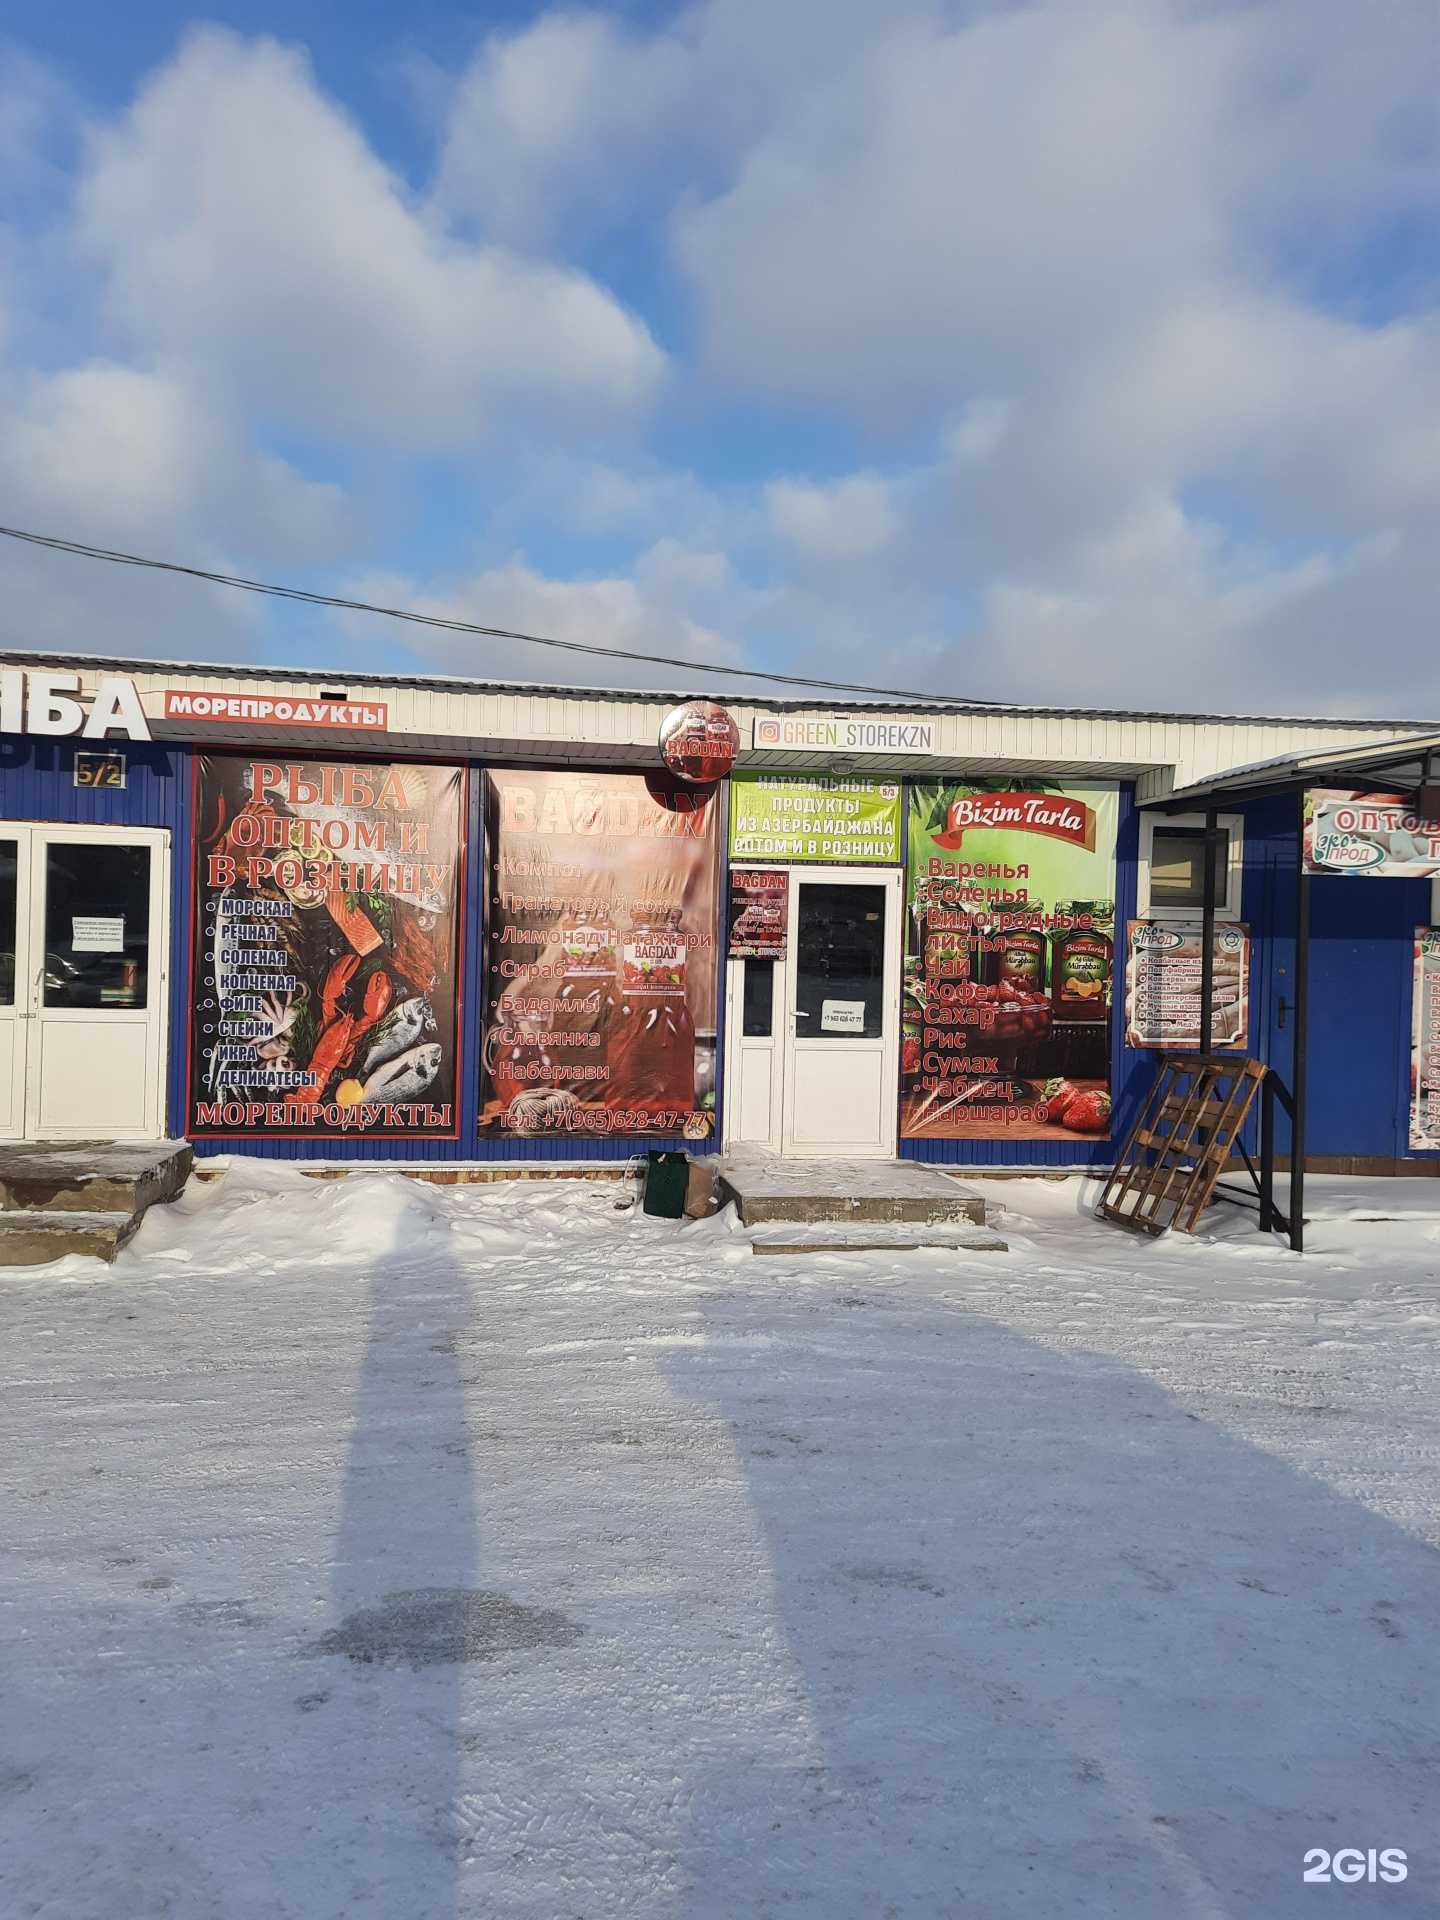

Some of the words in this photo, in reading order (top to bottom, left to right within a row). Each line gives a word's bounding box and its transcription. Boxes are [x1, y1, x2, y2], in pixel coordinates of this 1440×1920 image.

[168, 695, 383, 726] МОРЕПРОДУКТЫ
[784, 722, 931, 749] GREEN_STOREKZN
[78, 763, 121, 785] 5/2
[758, 776, 875, 793] НАТУРАЛЬНЫЕ
[250, 763, 409, 810] РЫБА
[772, 797, 860, 814] ПРОДУКТЫ
[952, 800, 1023, 826] Bizim
[1024, 800, 1083, 830] Tarla
[231, 815, 387, 853] ОПТОМ
[400, 823, 429, 854] И
[736, 817, 757, 832] ИЗ
[762, 818, 895, 835] АЗЕРБАЙДЖАНА
[792, 839, 802, 853] И
[808, 840, 817, 854] В
[822, 841, 895, 856] РОЗНИЦУ
[1329, 848, 1370, 861] ПРОД
[207, 855, 236, 887] В
[247, 857, 452, 899] РОЗНИЦУ
[928, 858, 1029, 880] Варенья
[927, 881, 1029, 902] Соленья
[221, 899, 291, 917] МОРСКАЯ
[502, 892, 628, 913] Гранатовый
[926, 906, 1093, 931] Виноградные
[221, 925, 276, 941] РЕЧНАЯ
[500, 926, 602, 948] Лимонад
[608, 930, 712, 951] Натахтари
[1143, 935, 1173, 945] ПРОД
[220, 950, 287, 966] СОЛЕНАЯ
[925, 954, 970, 976] Чай
[500, 960, 566, 982] Сираб
[219, 974, 295, 990] КОПЧЕНАЯ
[924, 979, 988, 1004] Кофе
[219, 996, 262, 1012] ФИЛЕ
[500, 993, 600, 1015] Бадамлы
[923, 1003, 994, 1028] Сахар
[218, 1018, 274, 1036] СТЕЙКИ
[923, 1028, 967, 1049] Рис
[218, 1046, 257, 1061] ИКРА
[923, 1052, 999, 1076] Сумах
[218, 1070, 316, 1087] ДЕЛИКАТЕСЫ
[499, 1060, 610, 1080] Набеглави
[922, 1075, 1013, 1101] Чабрец
[196, 1102, 451, 1130] МОРЕПРОДУКТЫ
[498, 1111, 537, 1128] Тел:
[543, 1111, 706, 1131] +7(965)628-47-77
[923, 1101, 1049, 1127] Наршараб
